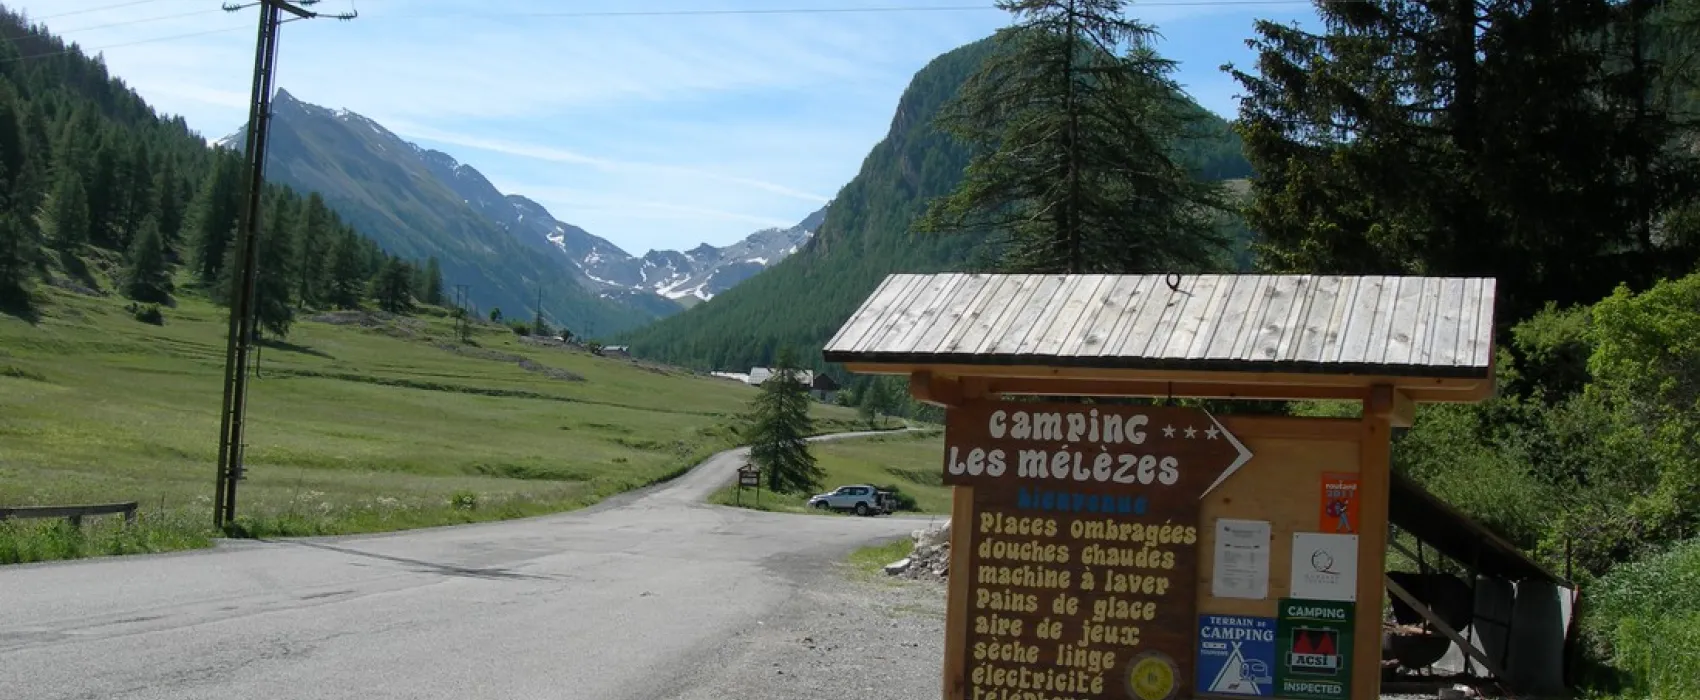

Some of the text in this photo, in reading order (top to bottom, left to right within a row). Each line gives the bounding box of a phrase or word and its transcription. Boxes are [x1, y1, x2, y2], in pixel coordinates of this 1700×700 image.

[1017, 485, 1148, 515] bienvenue
[1070, 518, 1198, 546] ombragées
[977, 537, 1176, 569] douches chaudes
[977, 565, 1170, 595] machine à laver
[1052, 593, 1080, 615] de
[1091, 596, 1157, 622] glace
[1209, 616, 1254, 627] TERRAIN
[1287, 605, 1346, 619] CAMPING
[974, 613, 1141, 647] aire de jeux
[1200, 626, 1274, 642] CAMPING
[972, 636, 1116, 672] sèche linge
[971, 661, 1105, 694] électricité
[1283, 681, 1343, 695] INSPECTED
